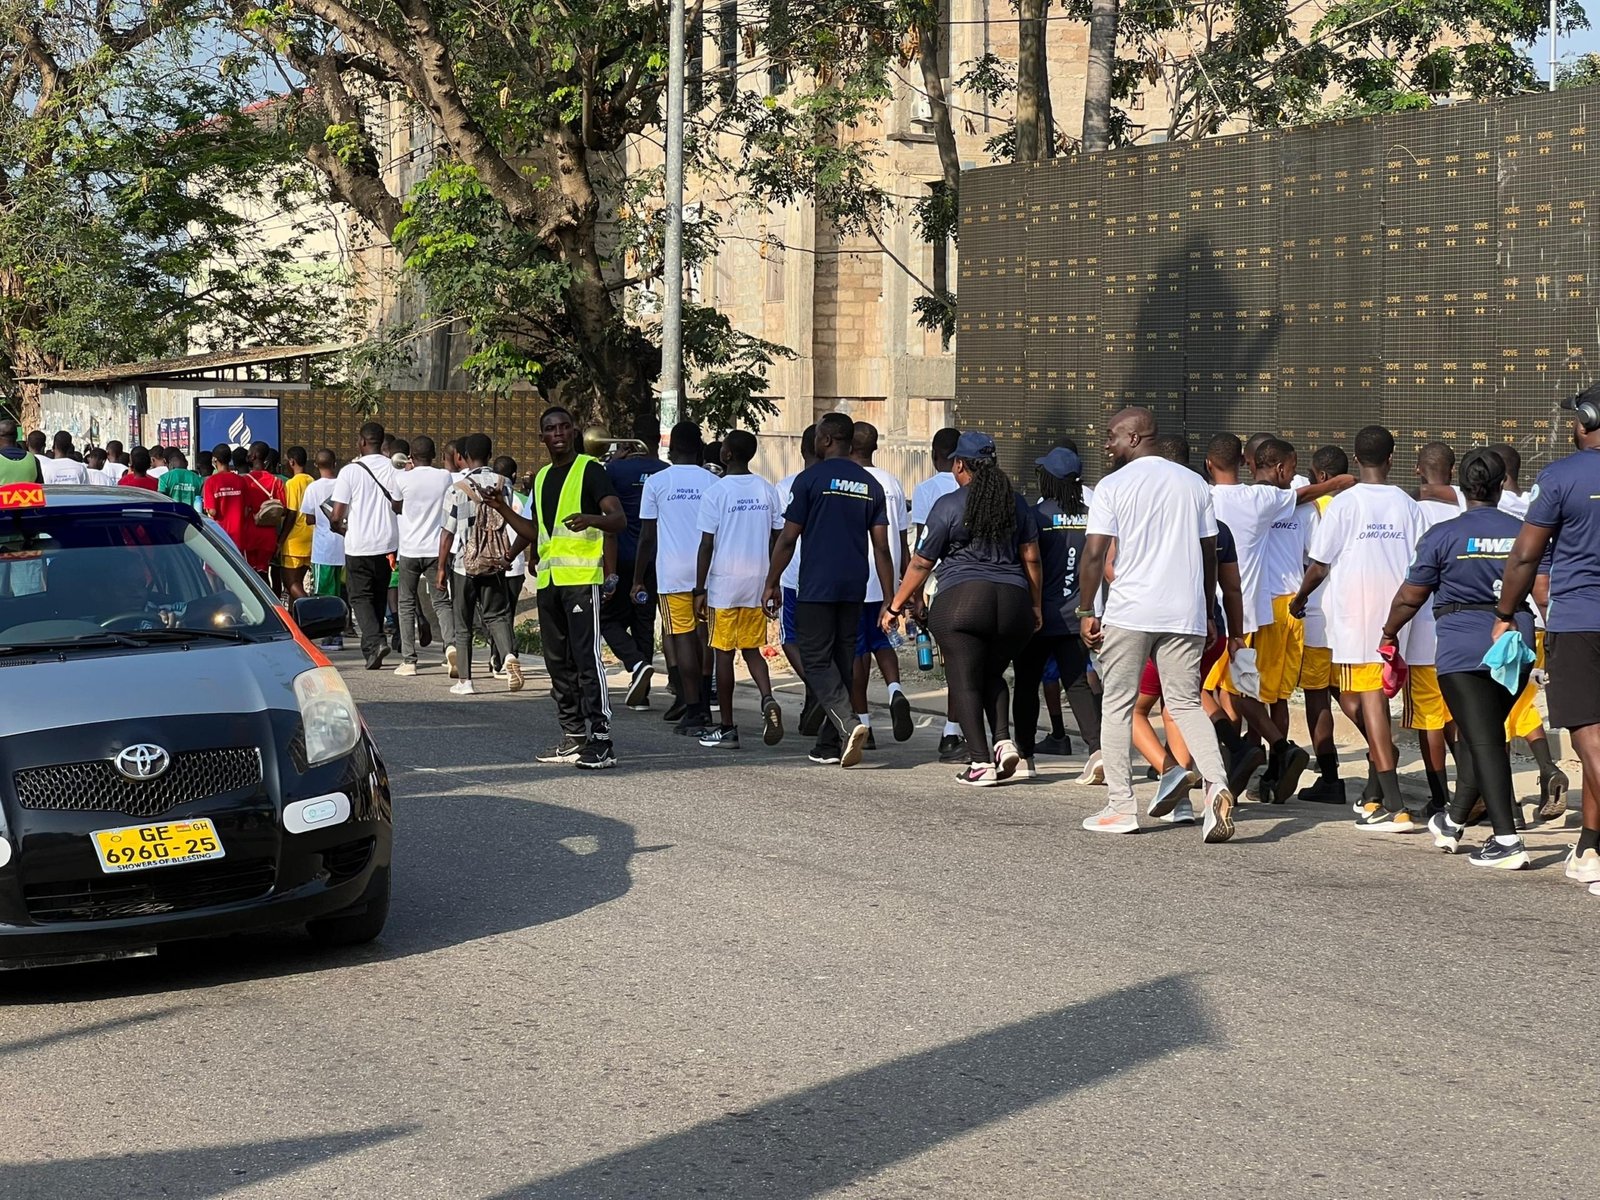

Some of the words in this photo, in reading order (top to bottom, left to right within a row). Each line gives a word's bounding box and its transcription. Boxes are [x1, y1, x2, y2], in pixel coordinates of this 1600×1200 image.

[1506, 135, 1521, 143] DOVE
[1538, 131, 1553, 140] DOVE
[1570, 128, 1585, 136] DOVE
[1388, 161, 1402, 169] DOVE
[1417, 158, 1431, 166] DOVE
[1446, 155, 1460, 163] DOVE
[1476, 152, 1490, 160] DOVE
[1505, 206, 1520, 215] DOVE
[1537, 204, 1552, 212] DOVE
[1570, 201, 1584, 209] DOVE
[1387, 229, 1401, 237] DOVE
[1416, 226, 1430, 234] DOVE
[1445, 224, 1459, 232] DOVE
[1474, 222, 1488, 230] DOVE
[1504, 277, 1519, 286] DOVE
[1536, 276, 1551, 284] DOVE
[1568, 274, 1583, 282] DOVE
[1387, 296, 1401, 304] DOVE
[1415, 294, 1429, 302] DOVE
[1444, 293, 1458, 301] DOVE
[1474, 292, 1488, 300] DOVE
[1503, 349, 1518, 357] DOVE
[1535, 348, 1550, 357] DOVE
[1568, 347, 1583, 355] DOVE
[1386, 363, 1400, 371] DOVE
[1414, 363, 1428, 371] DOVE
[1443, 362, 1457, 370] DOVE
[1473, 362, 1487, 370] DOVE
[1502, 420, 1517, 428] DOVE
[1534, 420, 1549, 428] DOVE
[1413, 430, 1427, 438] DOVE
[1442, 431, 1456, 439] DOVE
[1472, 432, 1486, 440] DOVE
[0, 489, 43, 504] TAXI
[728, 504, 746, 513] LOMO
[1271, 522, 1298, 530] JONES
[1066, 547, 1076, 570] ODI
[138, 826, 173, 842] GE
[117, 860, 158, 870] SHOWERS
[172, 852, 212, 864] BLESSING
